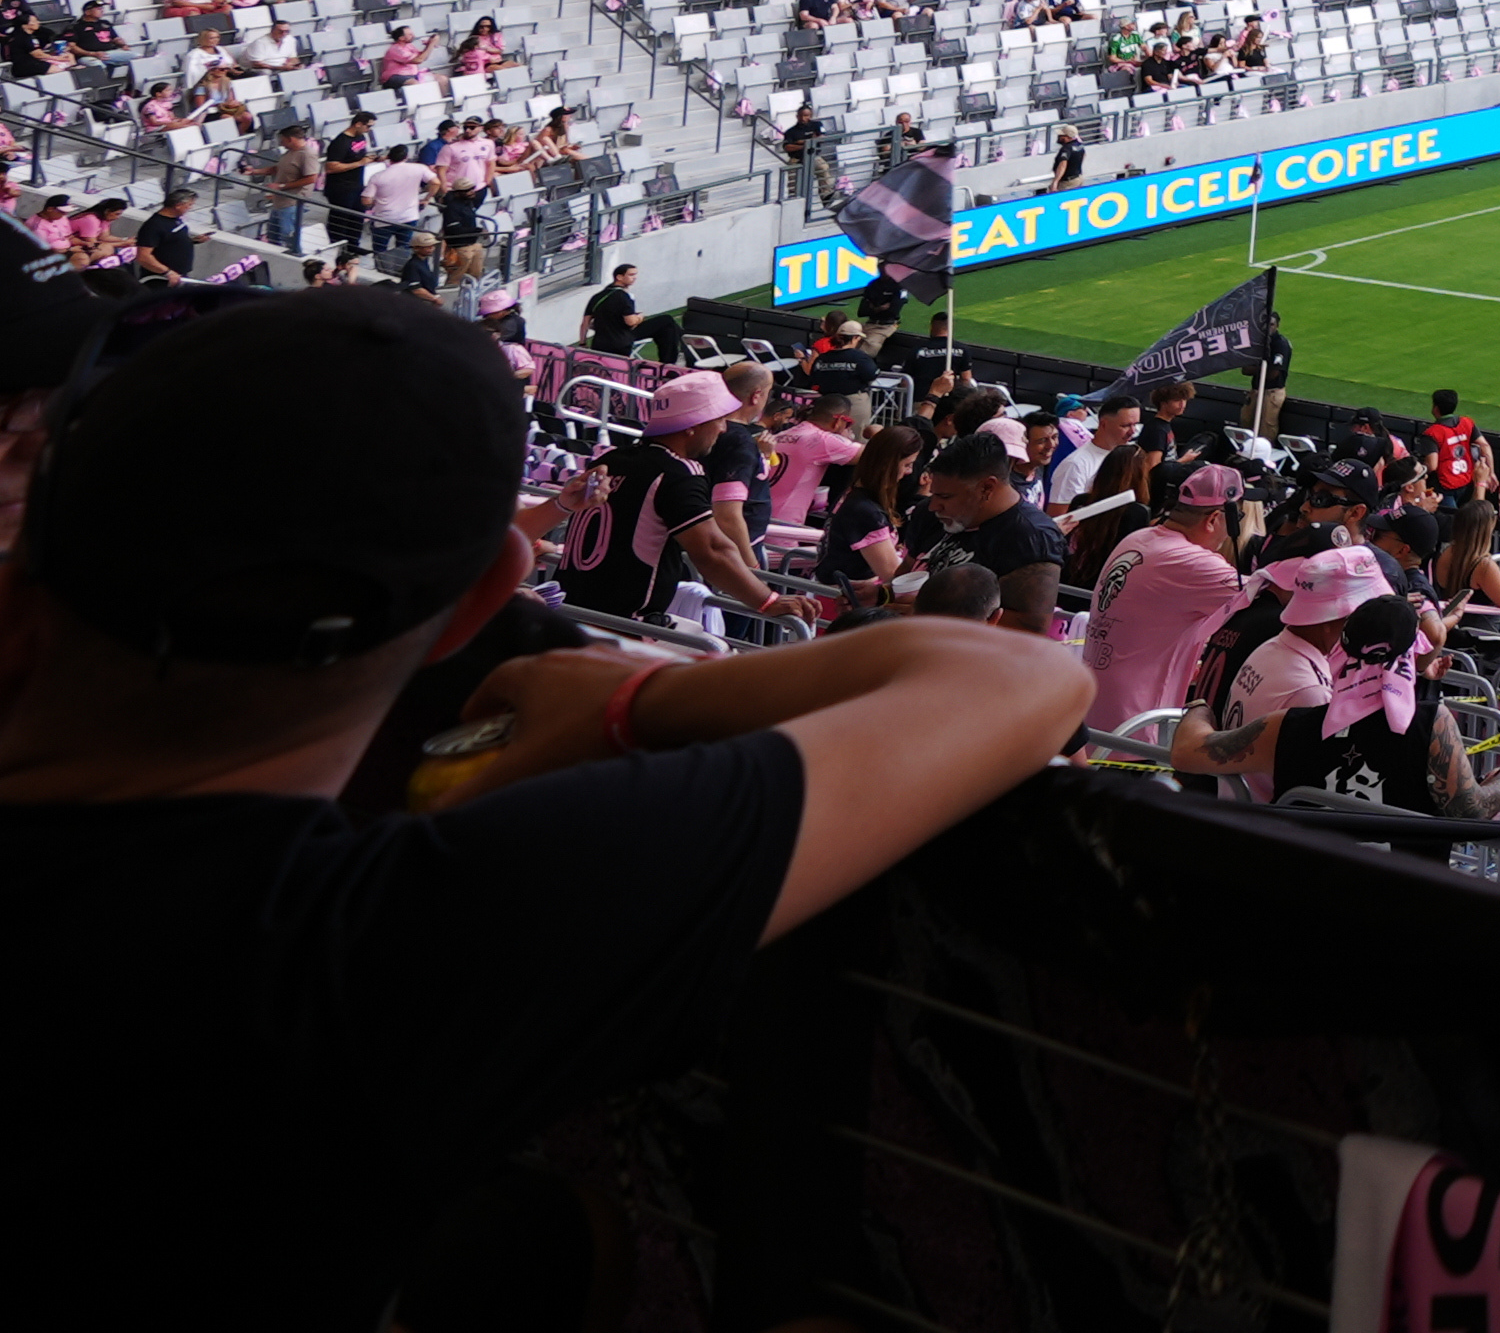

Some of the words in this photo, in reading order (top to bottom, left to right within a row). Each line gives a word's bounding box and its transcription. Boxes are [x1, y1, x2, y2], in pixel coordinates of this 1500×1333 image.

[774, 245, 879, 299] TIN
[950, 203, 1046, 260] EAT
[1060, 191, 1129, 237] TO
[1145, 165, 1257, 219] ICED
[1275, 127, 1442, 191] COFFEE
